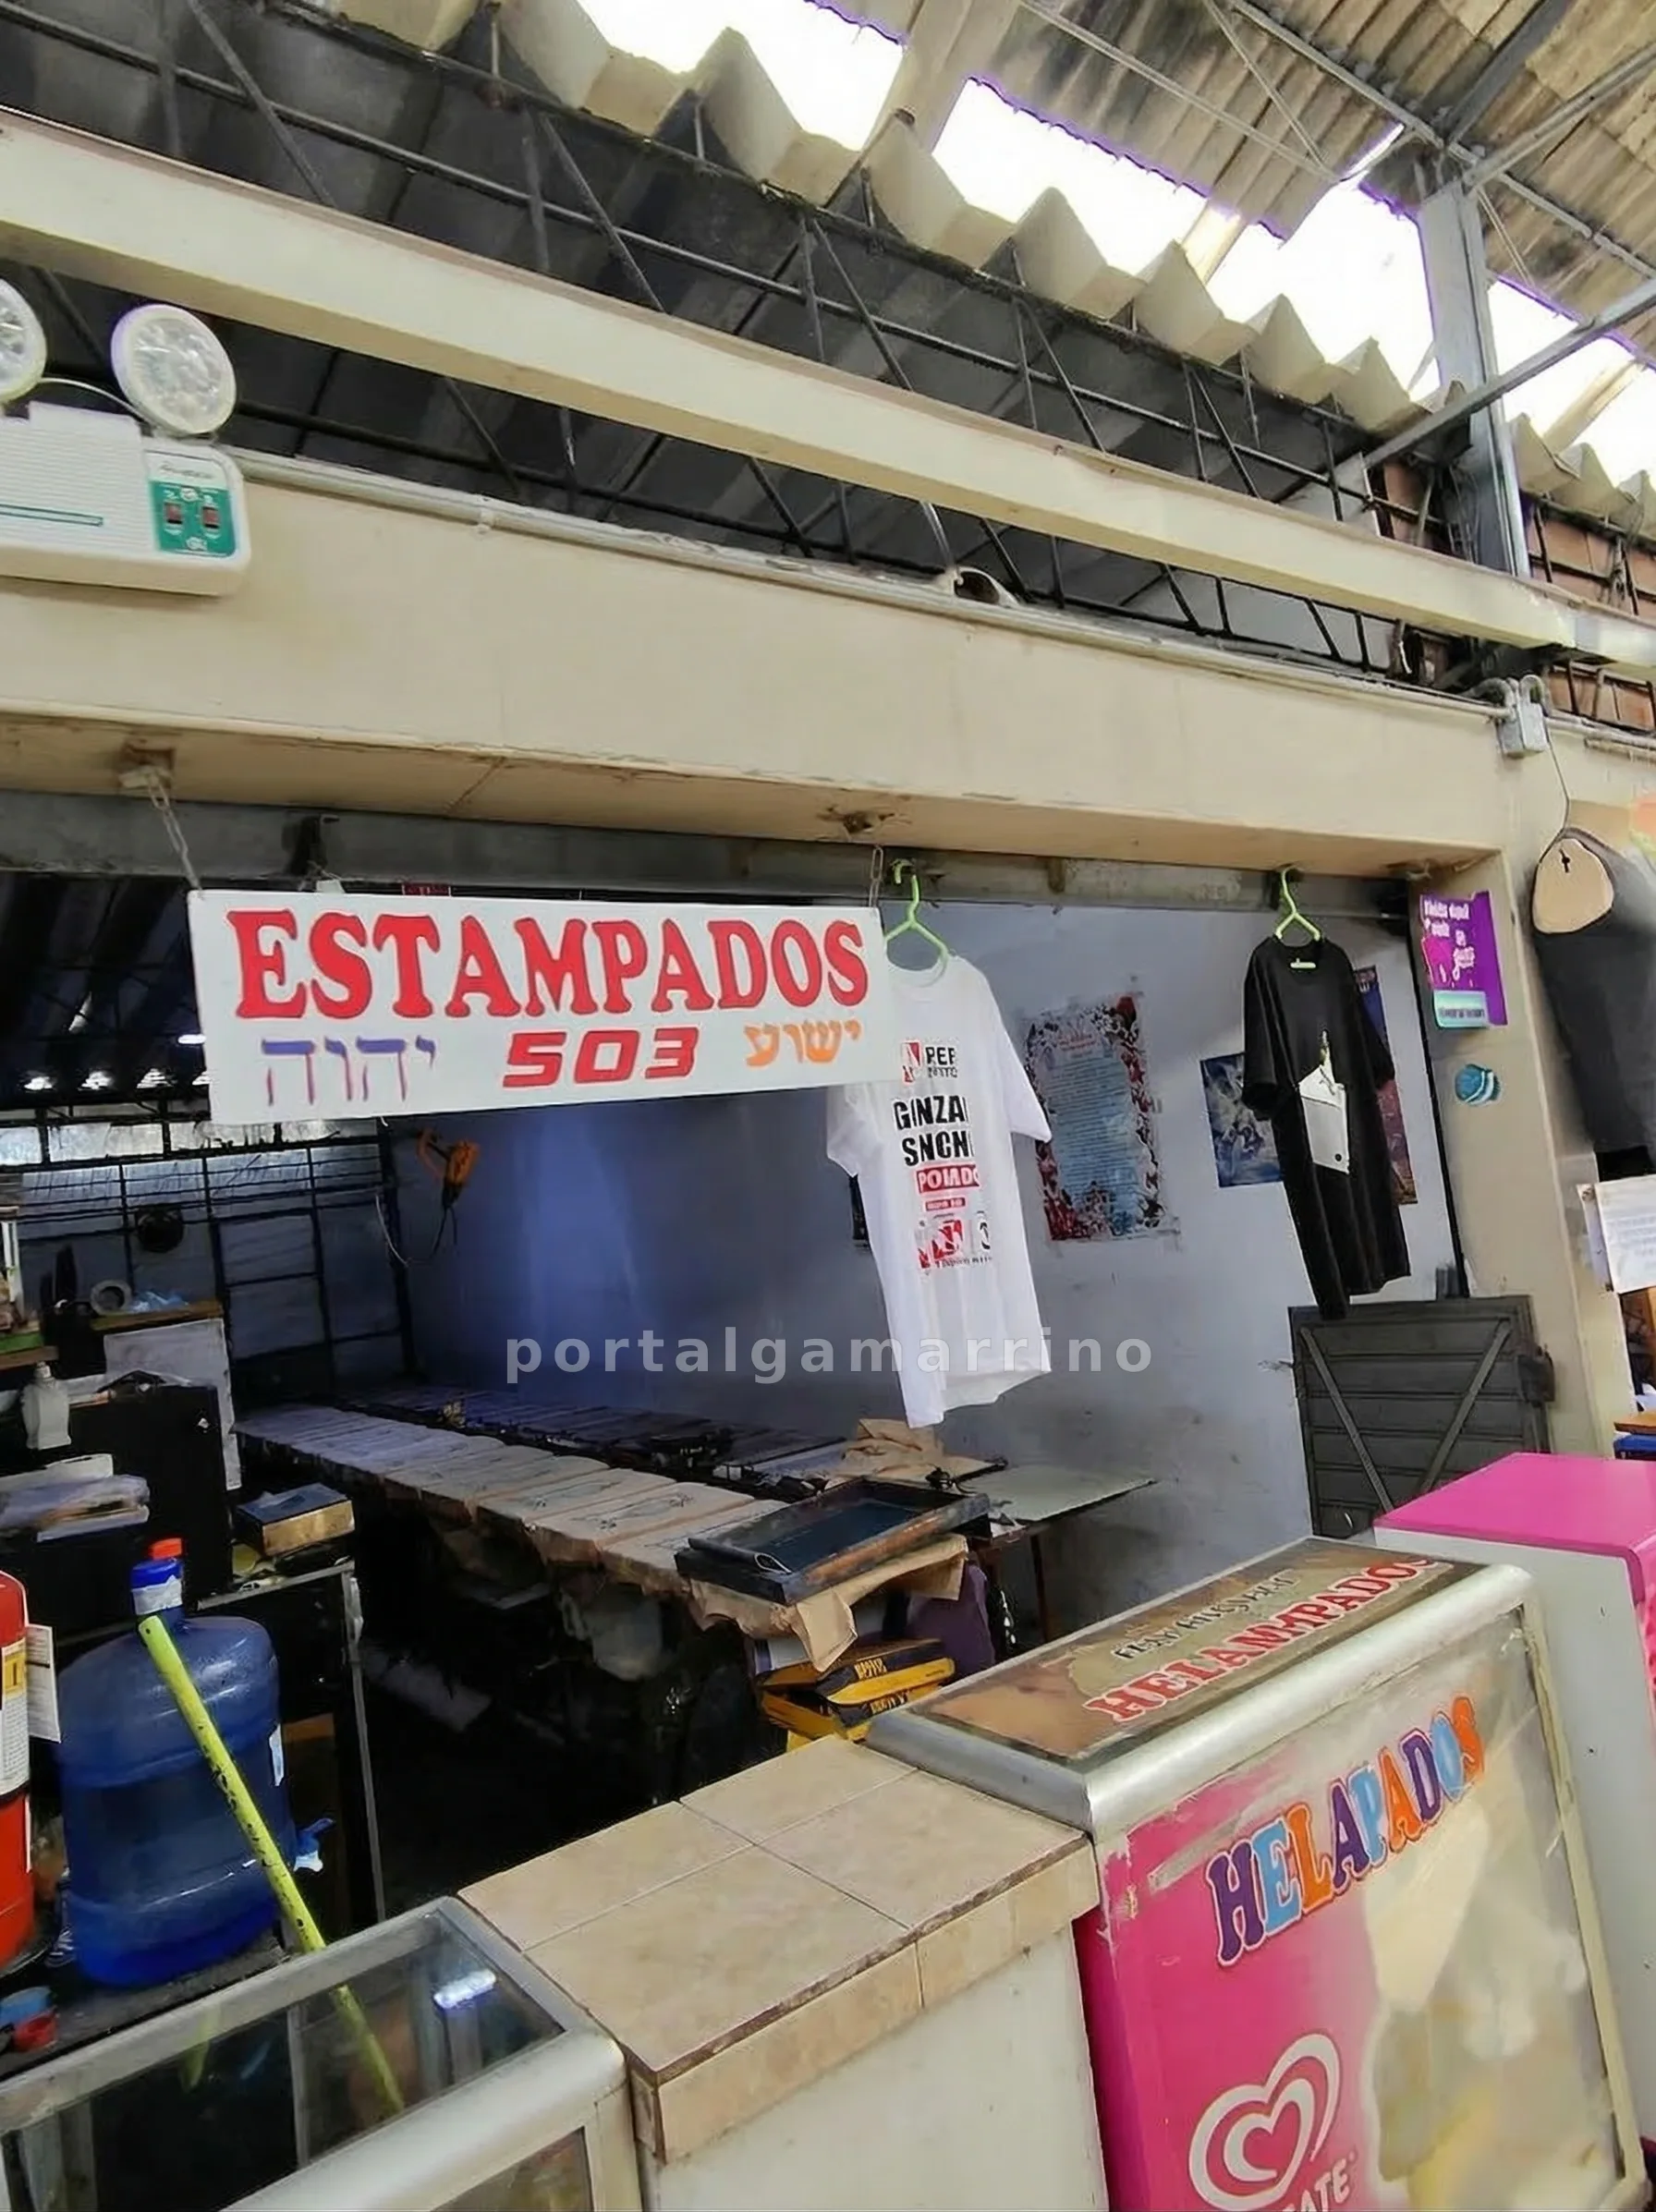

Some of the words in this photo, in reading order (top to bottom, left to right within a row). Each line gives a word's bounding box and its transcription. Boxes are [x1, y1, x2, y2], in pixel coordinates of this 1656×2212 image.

[226, 910, 871, 1020] ESTAMPADOS
[503, 1027, 700, 1088] 503
[1206, 1696, 1484, 1967] HELAPADOS
